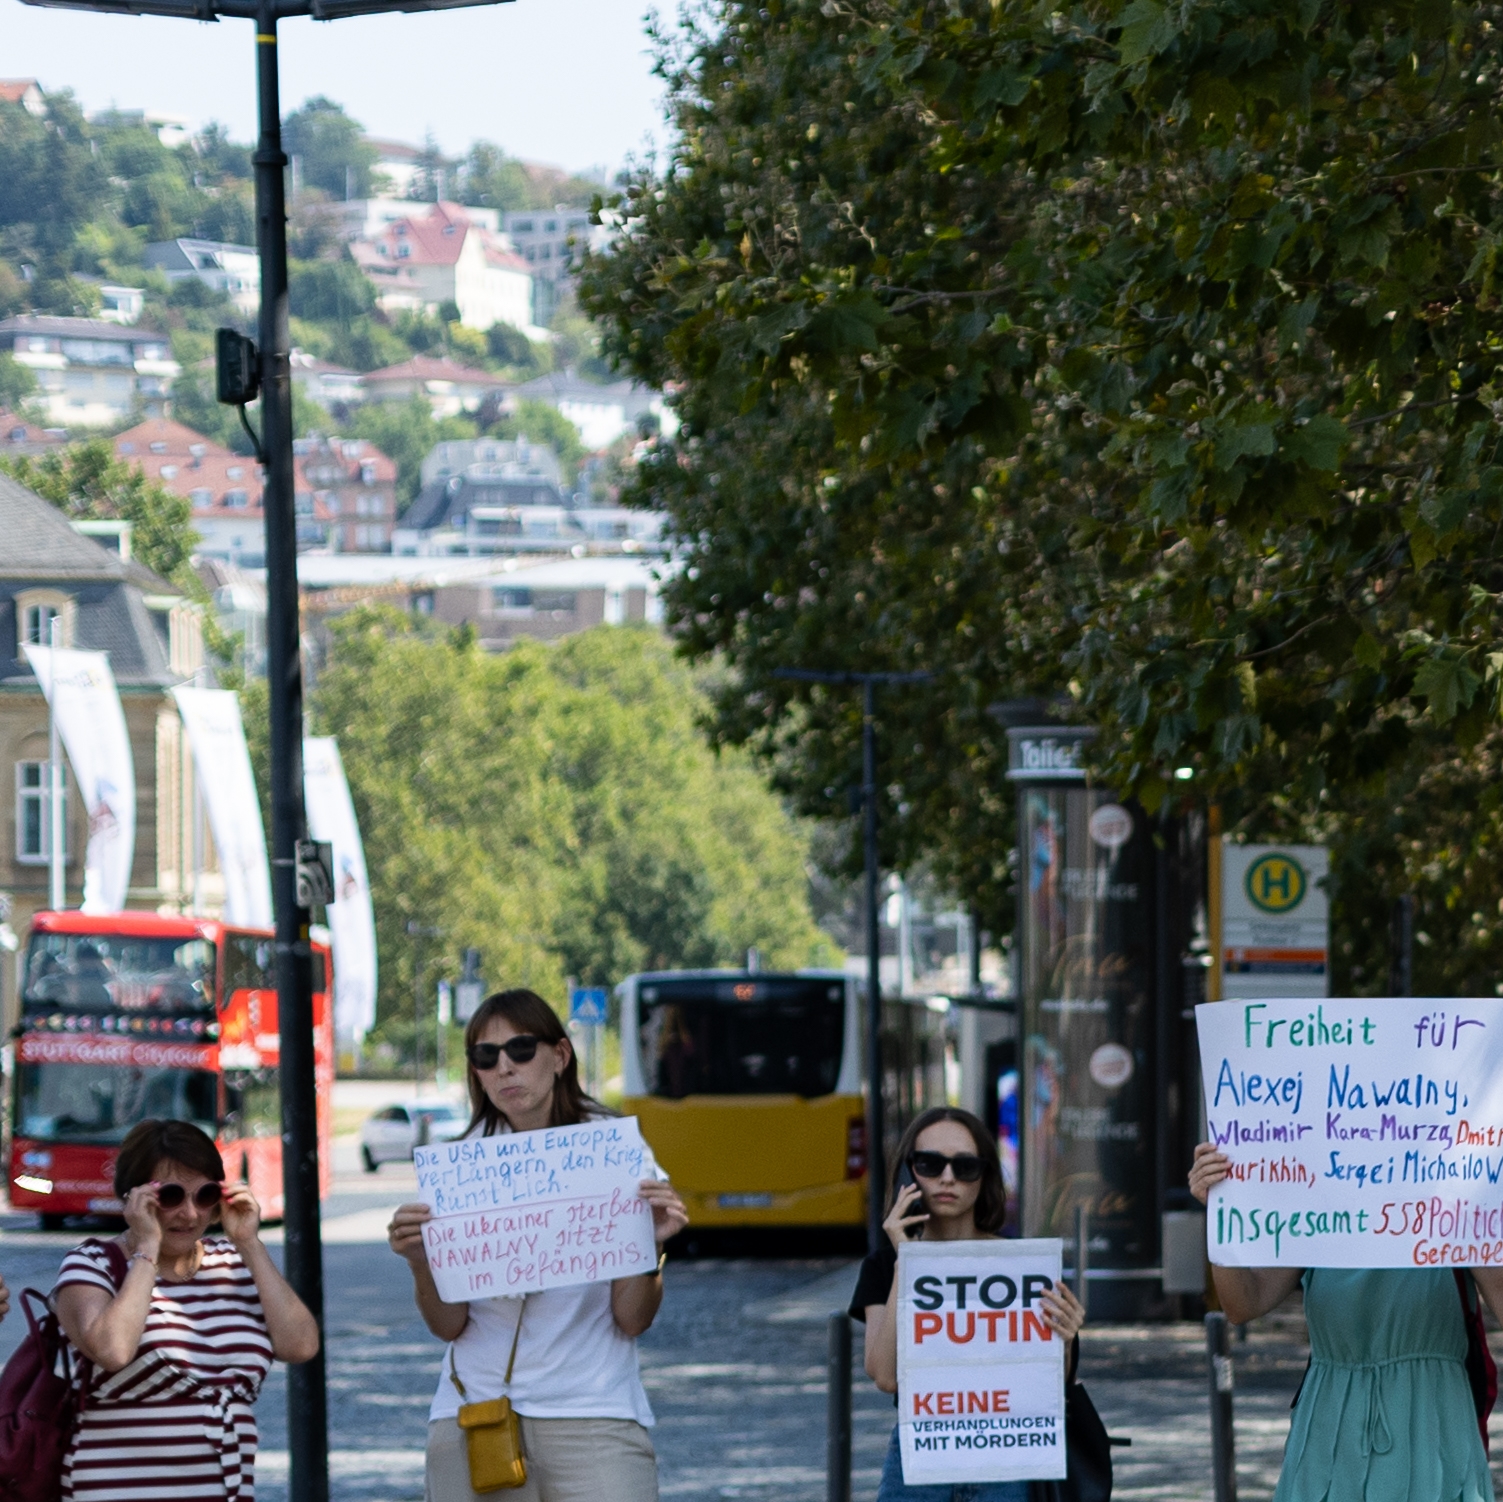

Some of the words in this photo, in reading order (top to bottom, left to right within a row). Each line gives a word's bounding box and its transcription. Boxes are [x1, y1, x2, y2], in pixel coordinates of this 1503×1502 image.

[1262, 867, 1289, 899] H
[1244, 1004, 1377, 1048] Freiheit
[1413, 1012, 1486, 1050] für
[1214, 1057, 1303, 1115] Alexej
[1327, 1063, 1469, 1116] Nawalny,
[415, 1152, 440, 1168] Die
[448, 1141, 486, 1166] USA
[496, 1136, 535, 1158] und
[544, 1126, 622, 1151] Europa
[1209, 1119, 1313, 1147] Wladimir
[562, 1150, 595, 1171] den
[604, 1144, 644, 1177] Krieg
[1225, 1155, 1316, 1189] kurikhin,
[428, 1226, 456, 1247] Die
[463, 1209, 553, 1239] Ukrainer
[1373, 1201, 1428, 1236] 558
[430, 1234, 538, 1270] NAWALNY
[556, 1220, 617, 1247] sitzt
[468, 1268, 493, 1291] im
[912, 1274, 1053, 1311] STOP
[913, 1310, 1053, 1344] PUTIN
[913, 1390, 1010, 1416] KEINE
[912, 1416, 1056, 1433] VERHANDLUNGEN
[914, 1435, 950, 1451] MIT
[954, 1429, 1057, 1450] MÖRDERN
